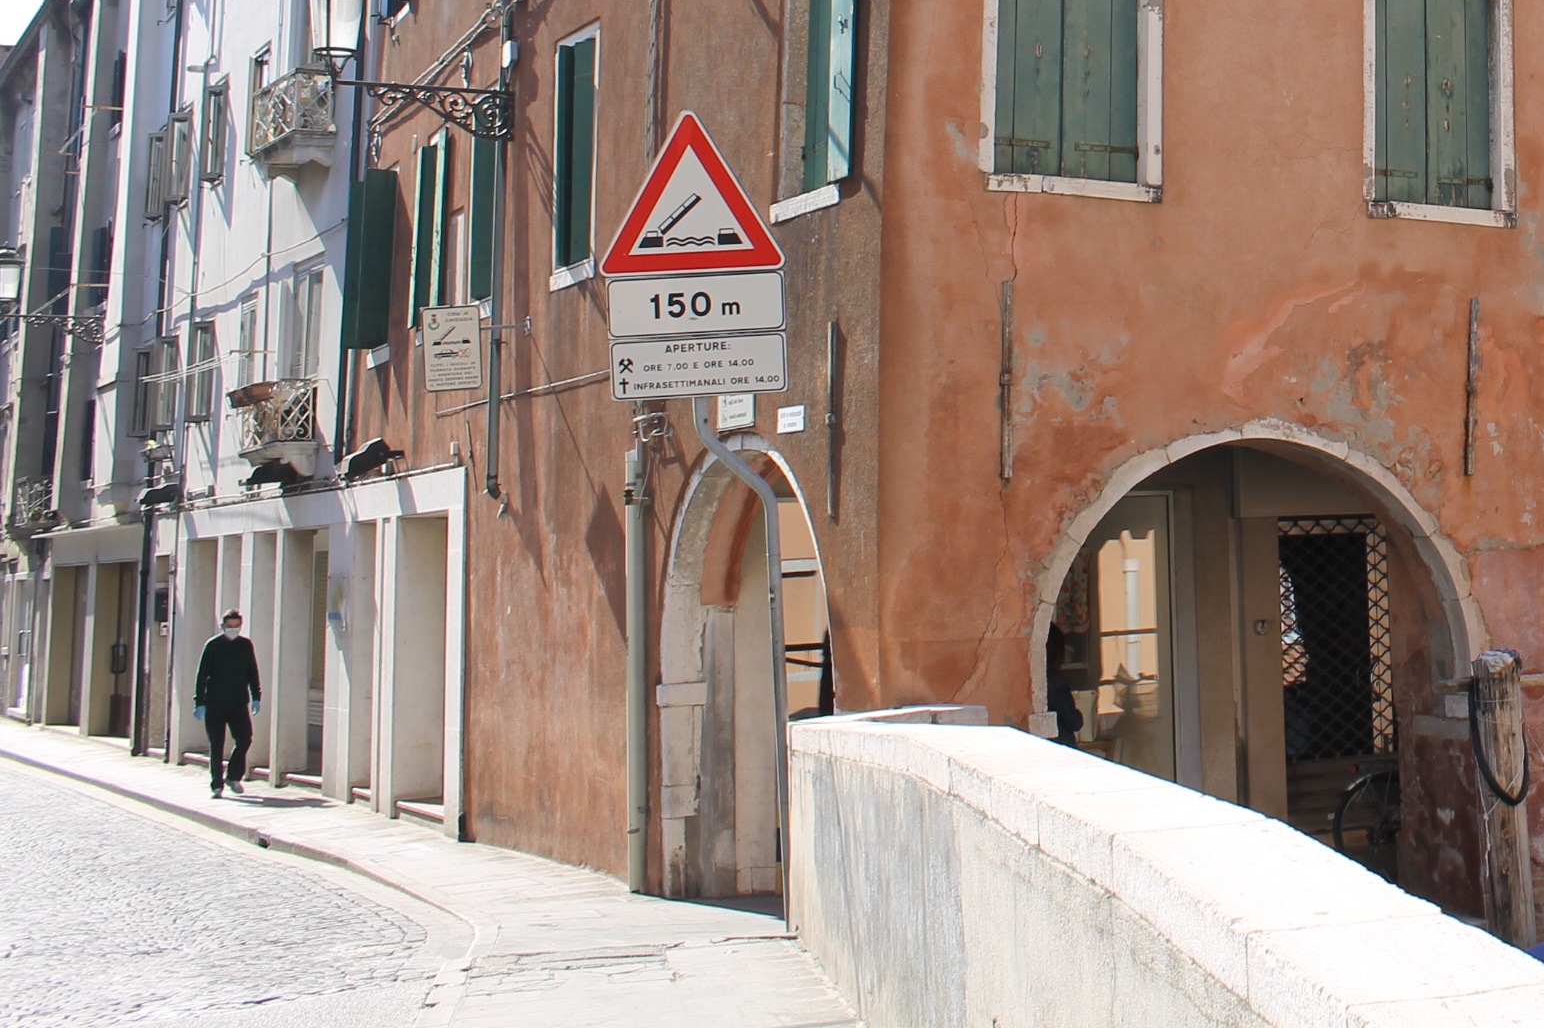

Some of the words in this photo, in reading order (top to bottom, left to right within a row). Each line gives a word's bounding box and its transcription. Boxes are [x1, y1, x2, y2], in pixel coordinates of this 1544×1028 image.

[650, 291, 712, 320] 150
[721, 301, 741, 316] m
[664, 341, 732, 354] APERTURE:
[643, 364, 663, 372] ORE
[667, 362, 689, 372] 7.00
[693, 361, 699, 370] E
[704, 360, 724, 369] ORE
[728, 358, 755, 368] 14.00
[633, 378, 726, 391] INFRASETTIMANALI
[730, 376, 750, 385] ORE
[754, 374, 780, 384] 14.00
